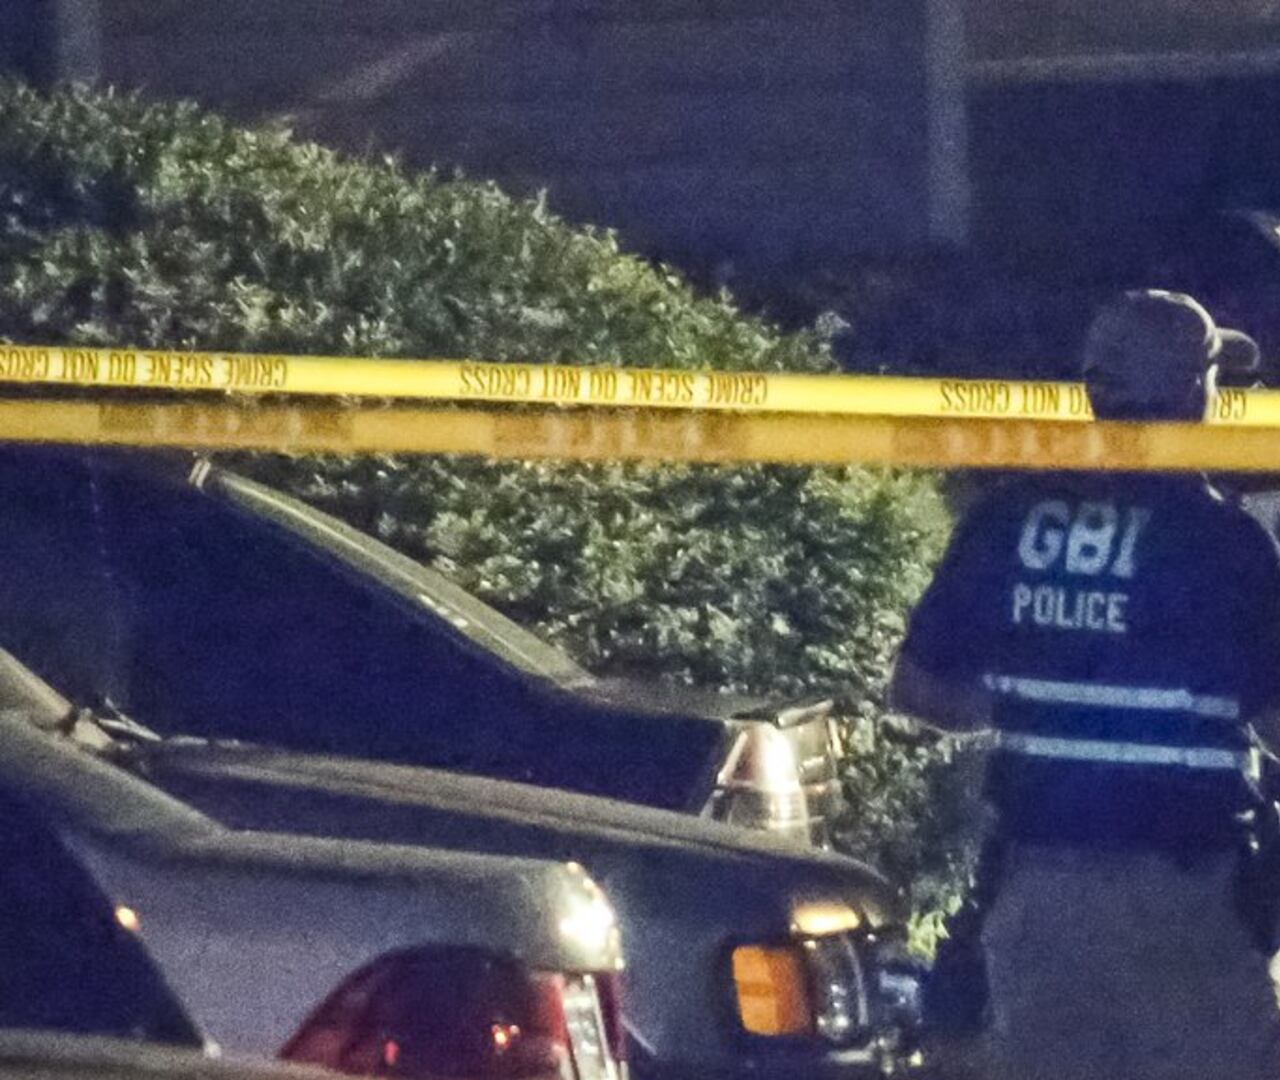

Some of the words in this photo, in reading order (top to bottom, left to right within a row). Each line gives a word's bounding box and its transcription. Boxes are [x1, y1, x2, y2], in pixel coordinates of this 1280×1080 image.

[0, 349, 49, 379] CROS
[62, 350, 98, 382] NOT
[109, 351, 136, 383] DO
[145, 353, 214, 385] SCENE
[222, 355, 287, 386] CRIME
[459, 365, 531, 396] CROSS
[542, 366, 581, 399] NOT
[590, 369, 618, 400] DO
[630, 371, 694, 402] SCENE
[703, 373, 768, 405] CRIME
[940, 380, 1010, 413] CROSS
[1022, 383, 1060, 414] NOT
[1017, 501, 1152, 577] GBI
[1012, 582, 1129, 633] POLICE
